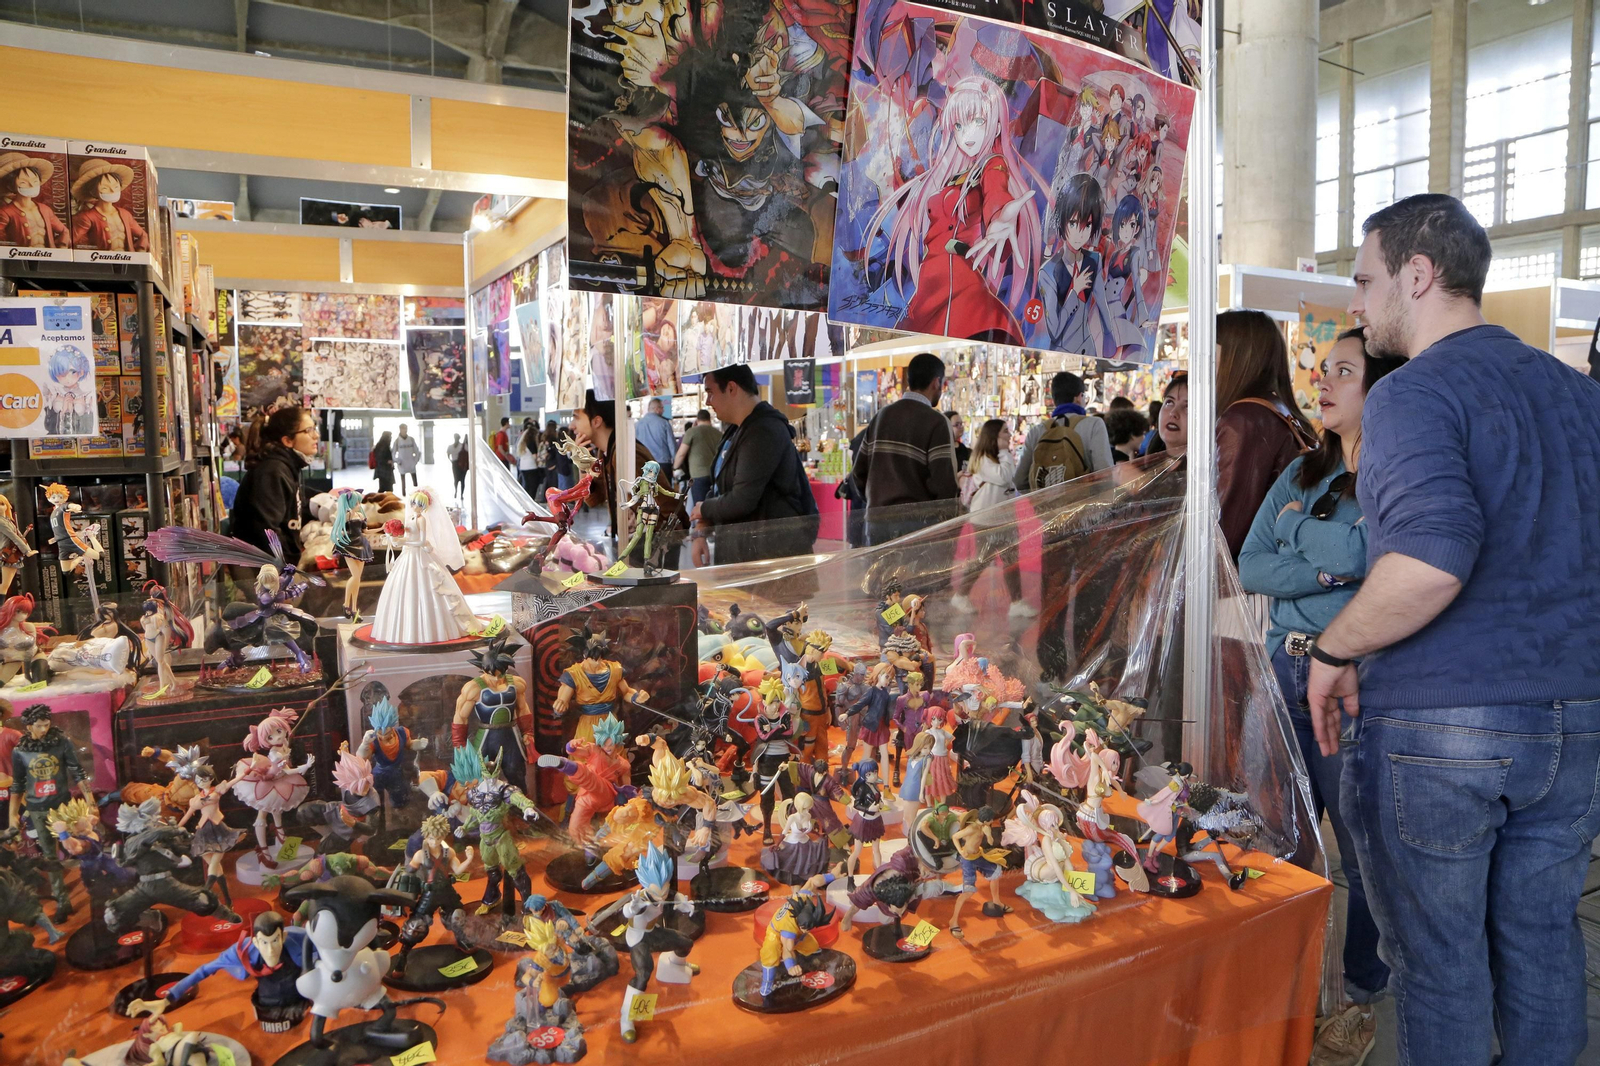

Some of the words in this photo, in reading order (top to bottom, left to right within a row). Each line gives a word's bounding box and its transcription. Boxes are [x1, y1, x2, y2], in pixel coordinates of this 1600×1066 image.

[1047, 2, 1138, 51] SLAYER
[1, 137, 46, 149] Grandista
[85, 144, 127, 155] Grandista
[9, 248, 52, 259] Grandista
[90, 251, 131, 262] Grandista
[1026, 304, 1042, 321] €5
[41, 334, 86, 342] Aceptamos
[884, 608, 901, 622] 45€
[38, 783, 56, 794] €29
[283, 842, 297, 860] 45€
[1068, 877, 1090, 892] 40€
[507, 931, 527, 943] 40€
[919, 926, 937, 944] 25€
[444, 961, 472, 976] 35€
[806, 970, 830, 988] 35€
[633, 998, 651, 1015] 40€
[262, 1020, 291, 1033] THIRD
[533, 1027, 558, 1048] 35€
